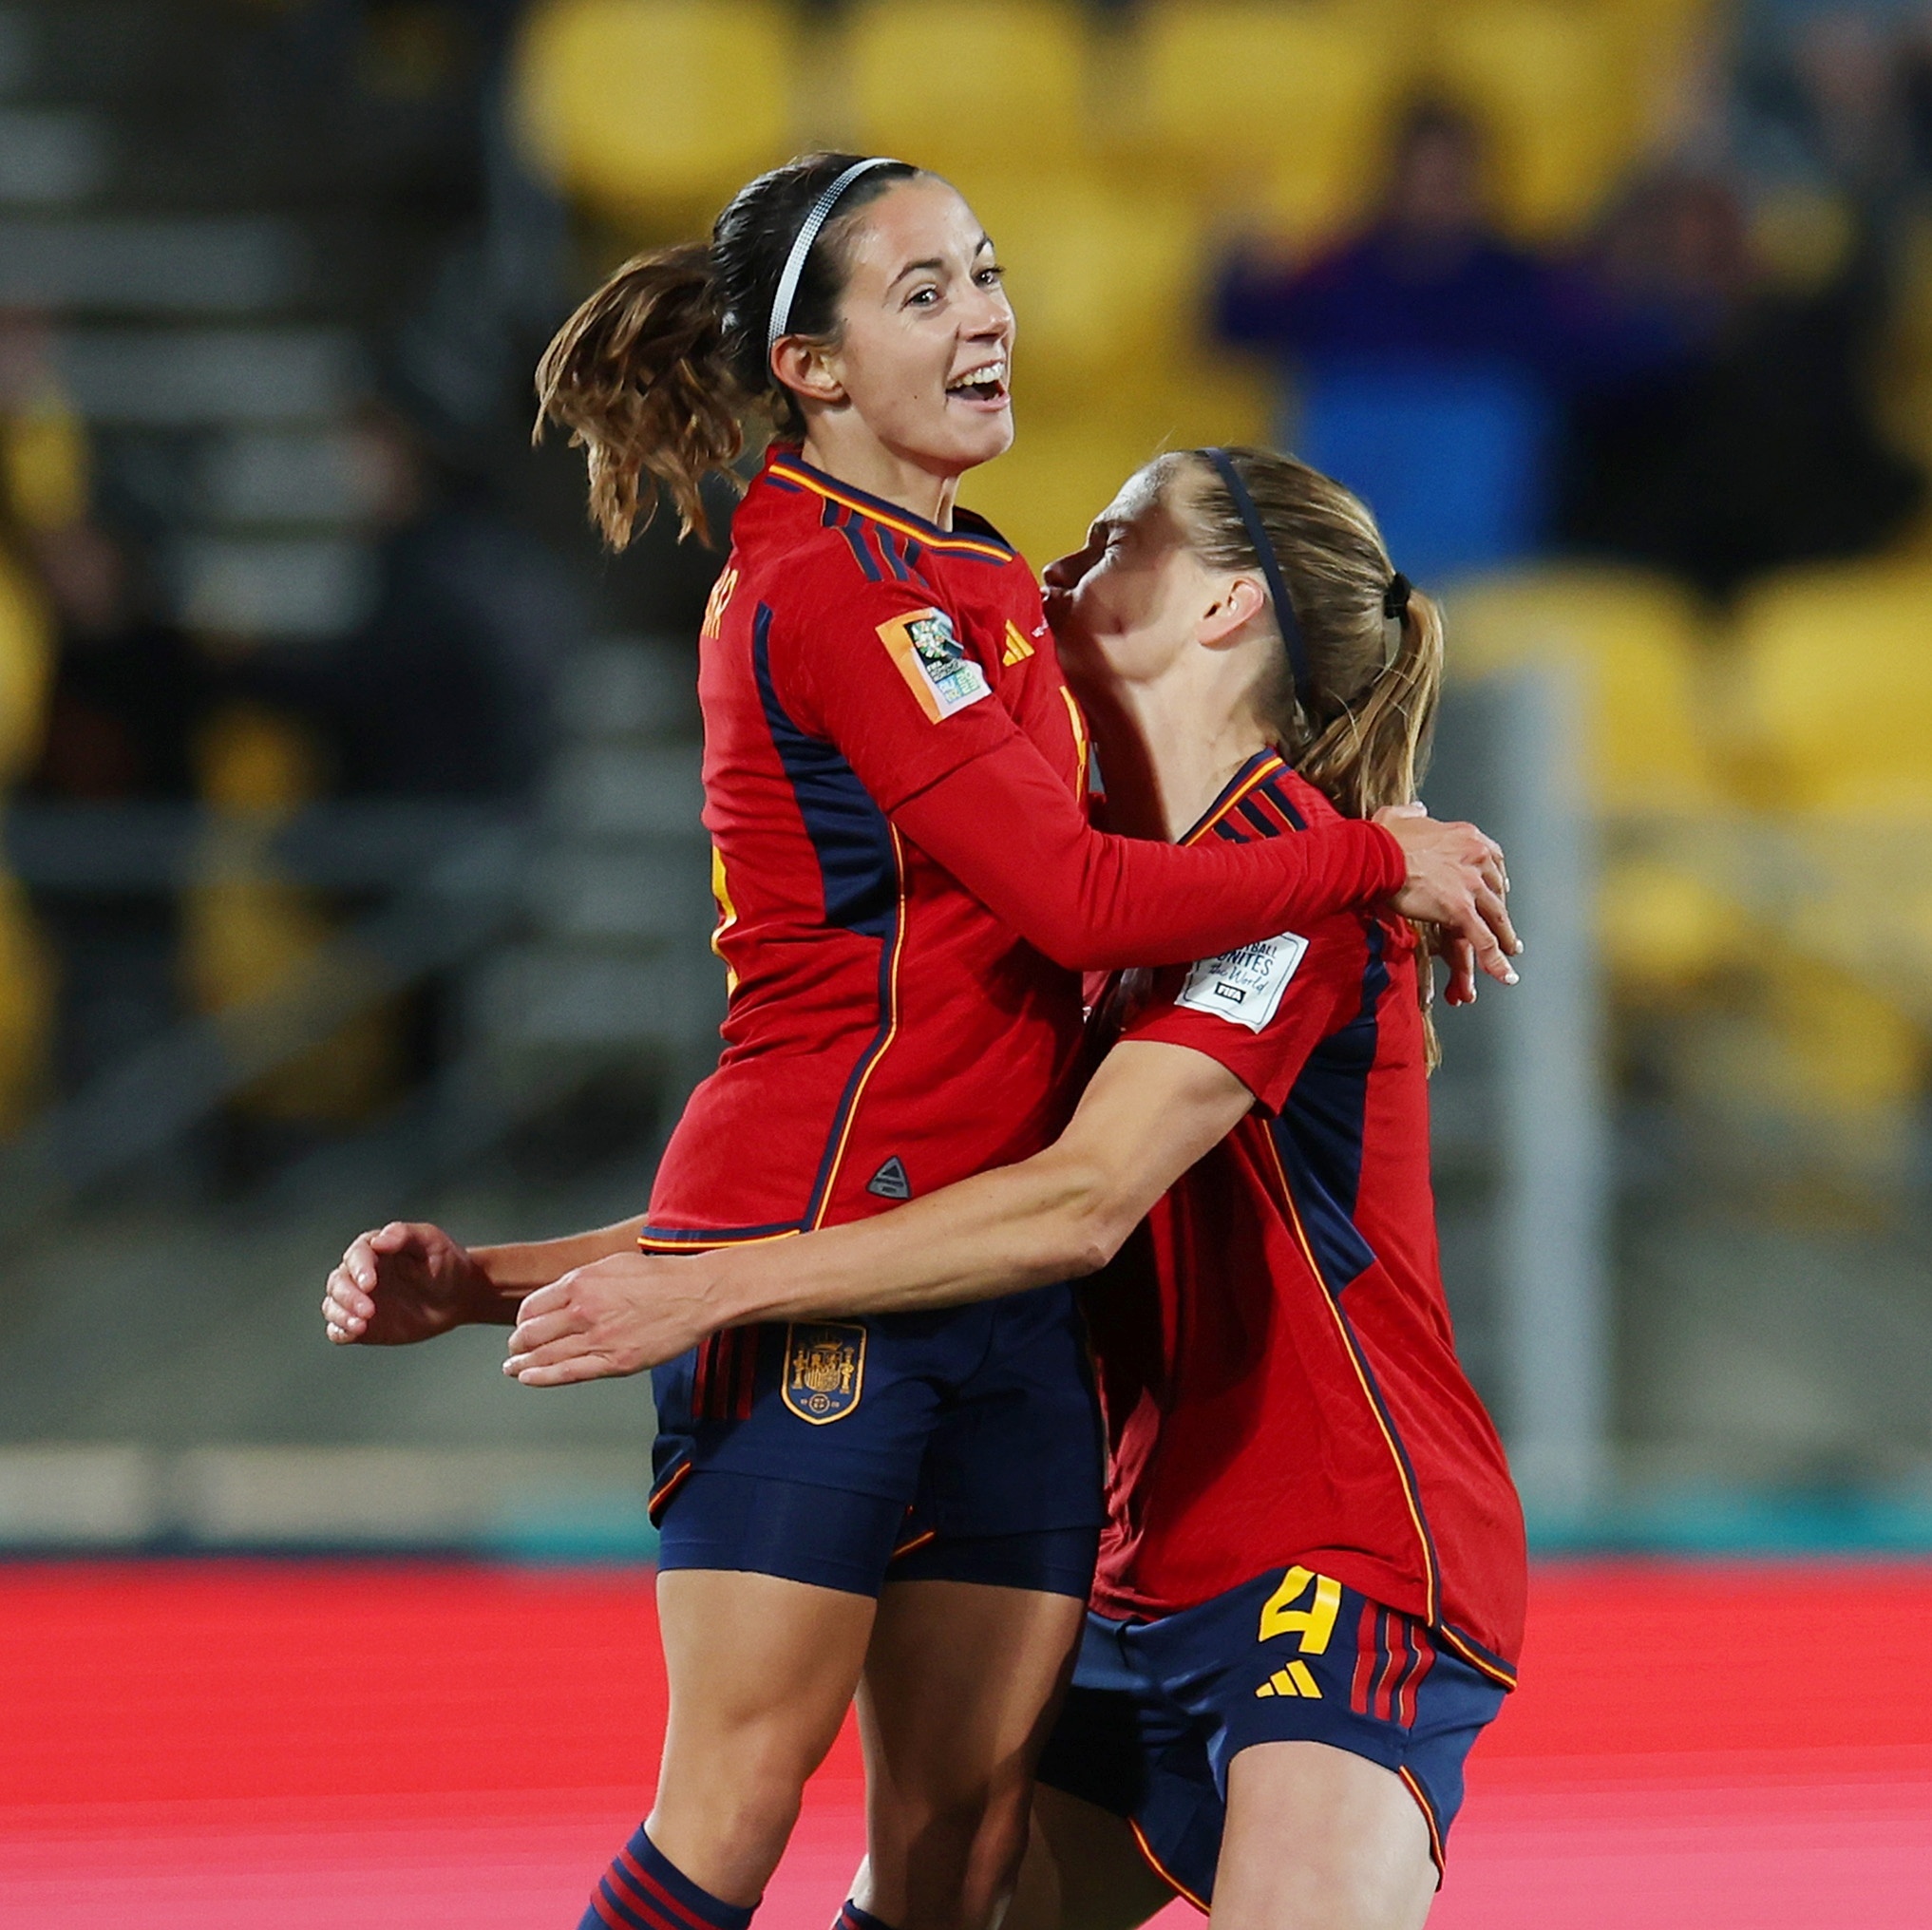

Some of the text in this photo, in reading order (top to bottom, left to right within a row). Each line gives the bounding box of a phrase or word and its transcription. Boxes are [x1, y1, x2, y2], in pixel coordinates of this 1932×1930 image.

[1217, 985, 1242, 1001] FIFA
[1228, 965, 1270, 995] World
[1258, 1564, 1342, 1656] 4
